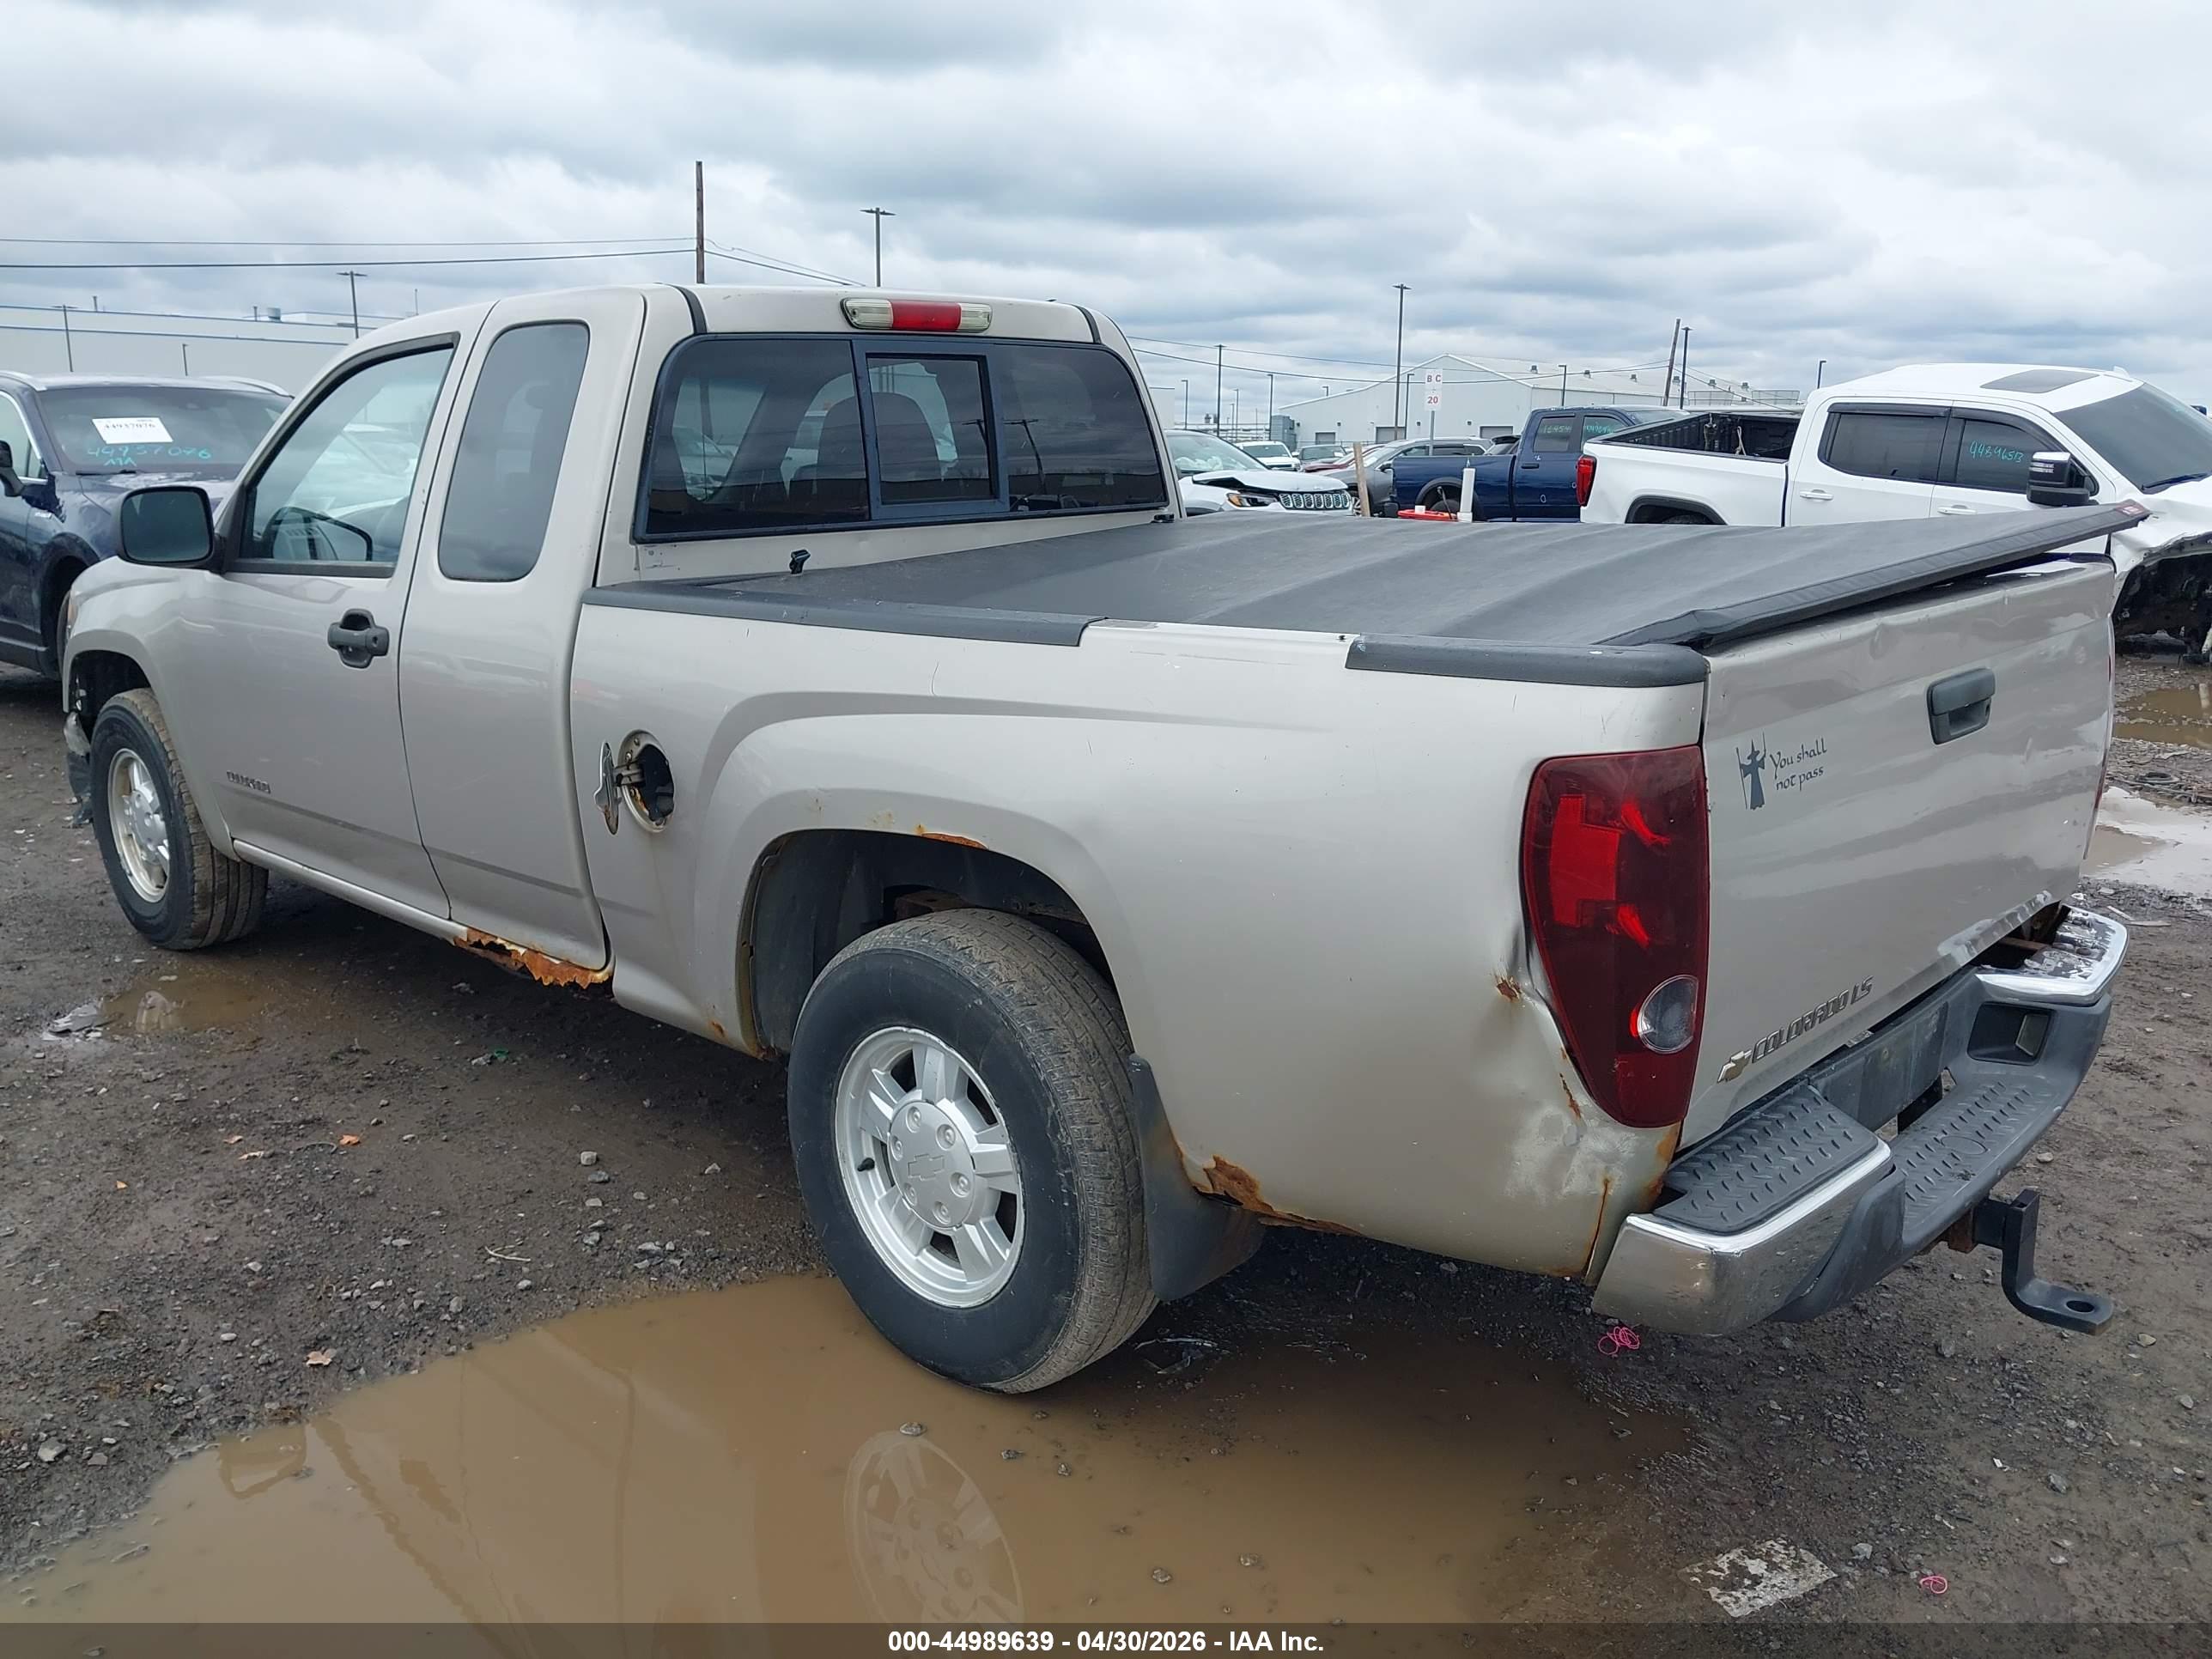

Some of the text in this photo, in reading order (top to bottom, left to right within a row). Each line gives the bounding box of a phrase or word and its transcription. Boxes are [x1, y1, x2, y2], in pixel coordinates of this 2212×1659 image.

[1427, 396, 1439, 404] 20
[1770, 737, 1828, 781] You shall
[1776, 766, 1825, 793] not pass
[1752, 975, 1874, 1064] COLORADO LS
